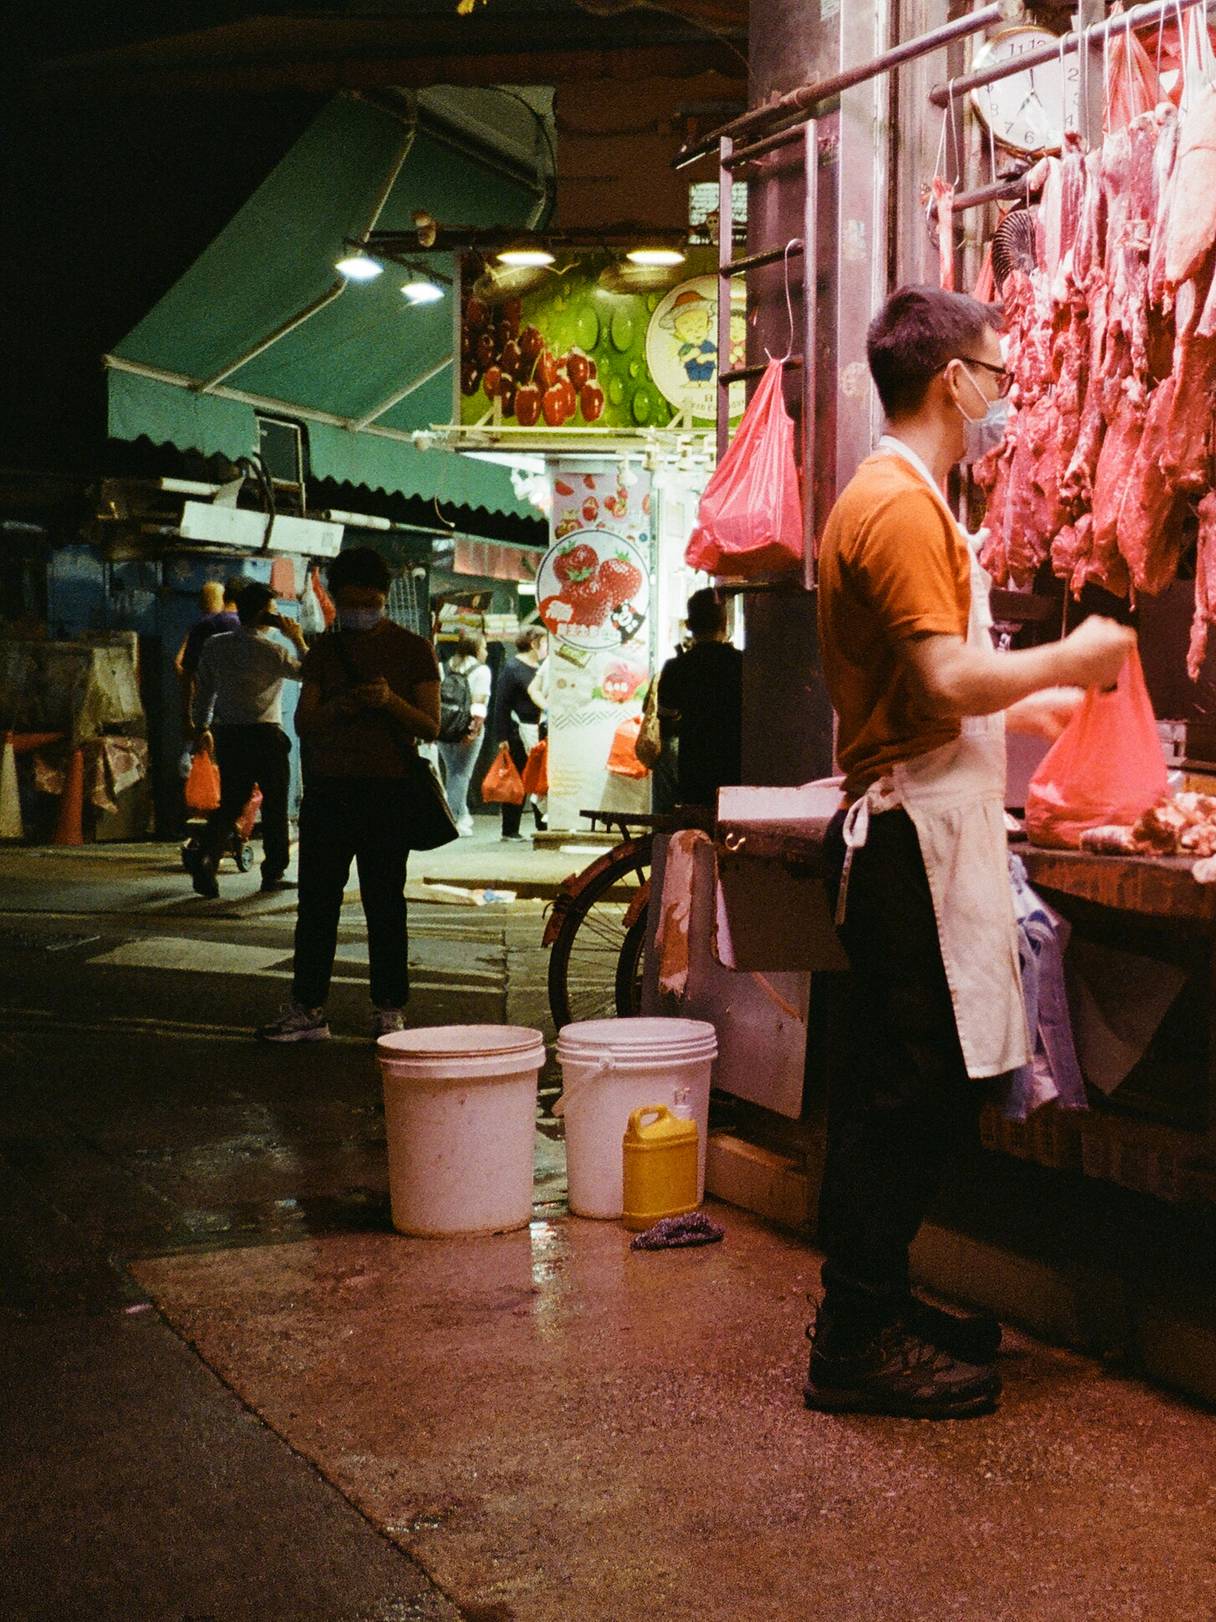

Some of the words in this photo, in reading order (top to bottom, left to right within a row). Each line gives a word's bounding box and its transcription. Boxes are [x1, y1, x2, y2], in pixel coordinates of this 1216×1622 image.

[1067, 68, 1079, 81] 2
[1064, 113, 1073, 126] 4
[1004, 121, 1014, 134] 7
[1024, 131, 1034, 144] 6
